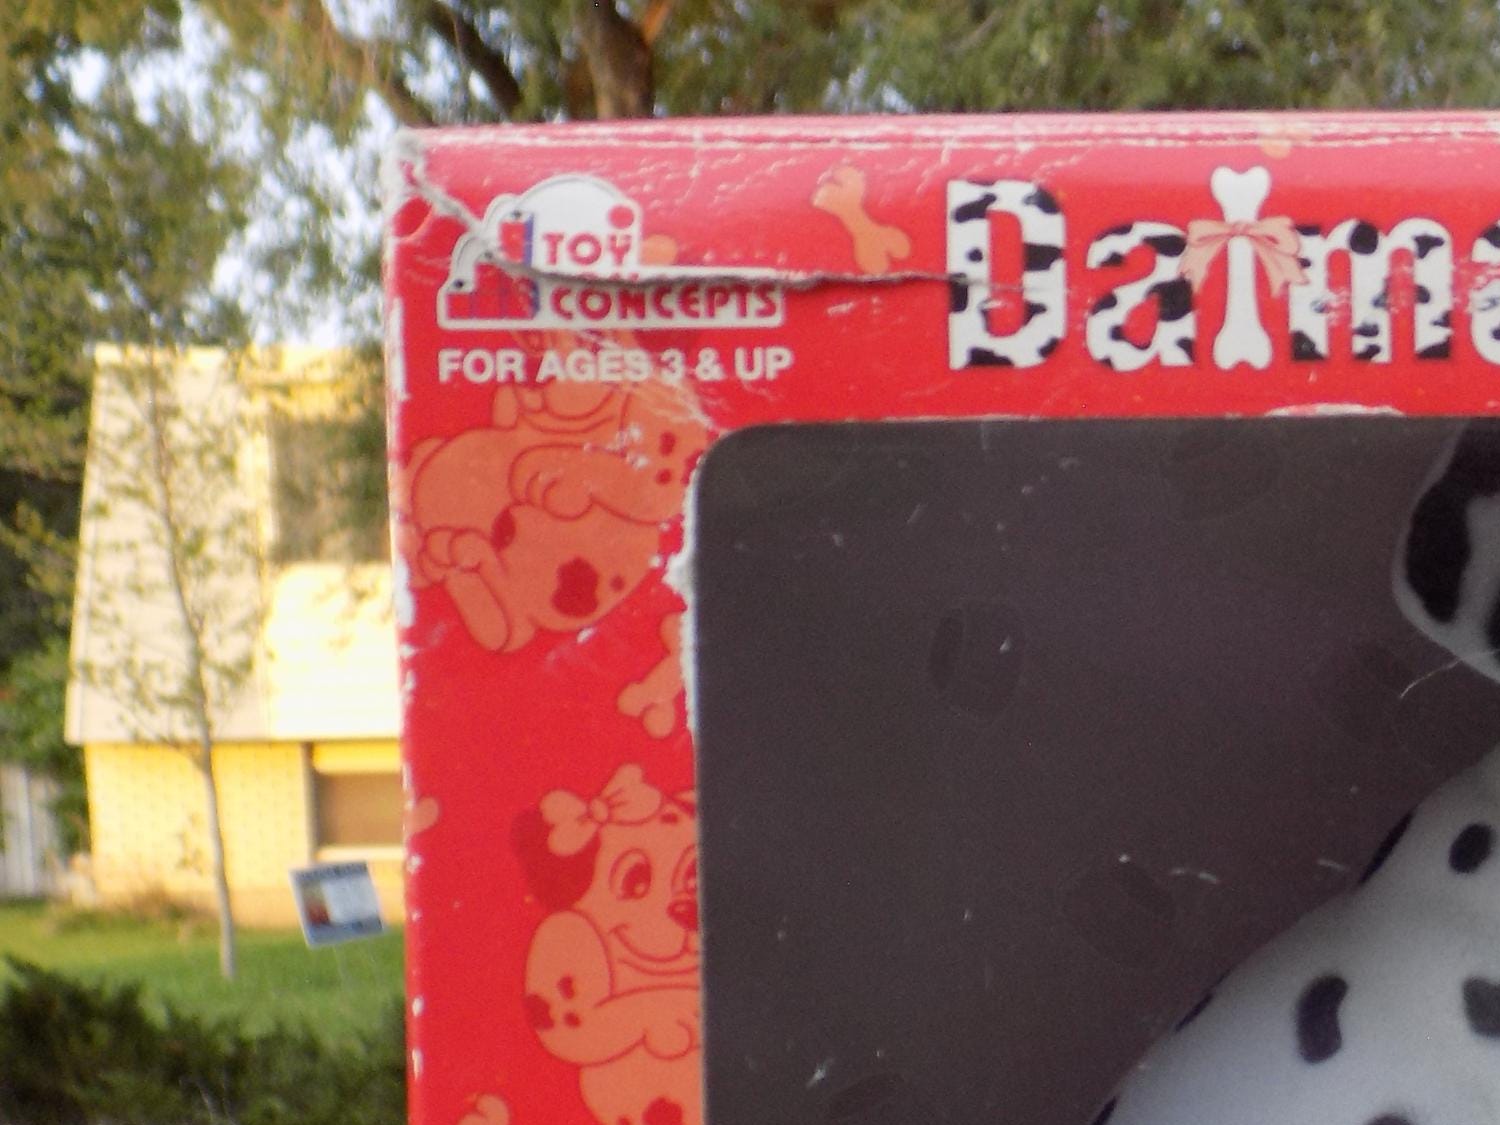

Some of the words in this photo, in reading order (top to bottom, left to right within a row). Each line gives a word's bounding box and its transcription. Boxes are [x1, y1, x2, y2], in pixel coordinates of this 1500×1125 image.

[542, 232, 633, 266] TOY
[551, 280, 778, 321] CONCEPTS
[437, 348, 525, 383] FOR
[536, 347, 653, 383] AGES
[659, 347, 684, 382] 3
[694, 346, 726, 382] &
[734, 345, 794, 381] UP
